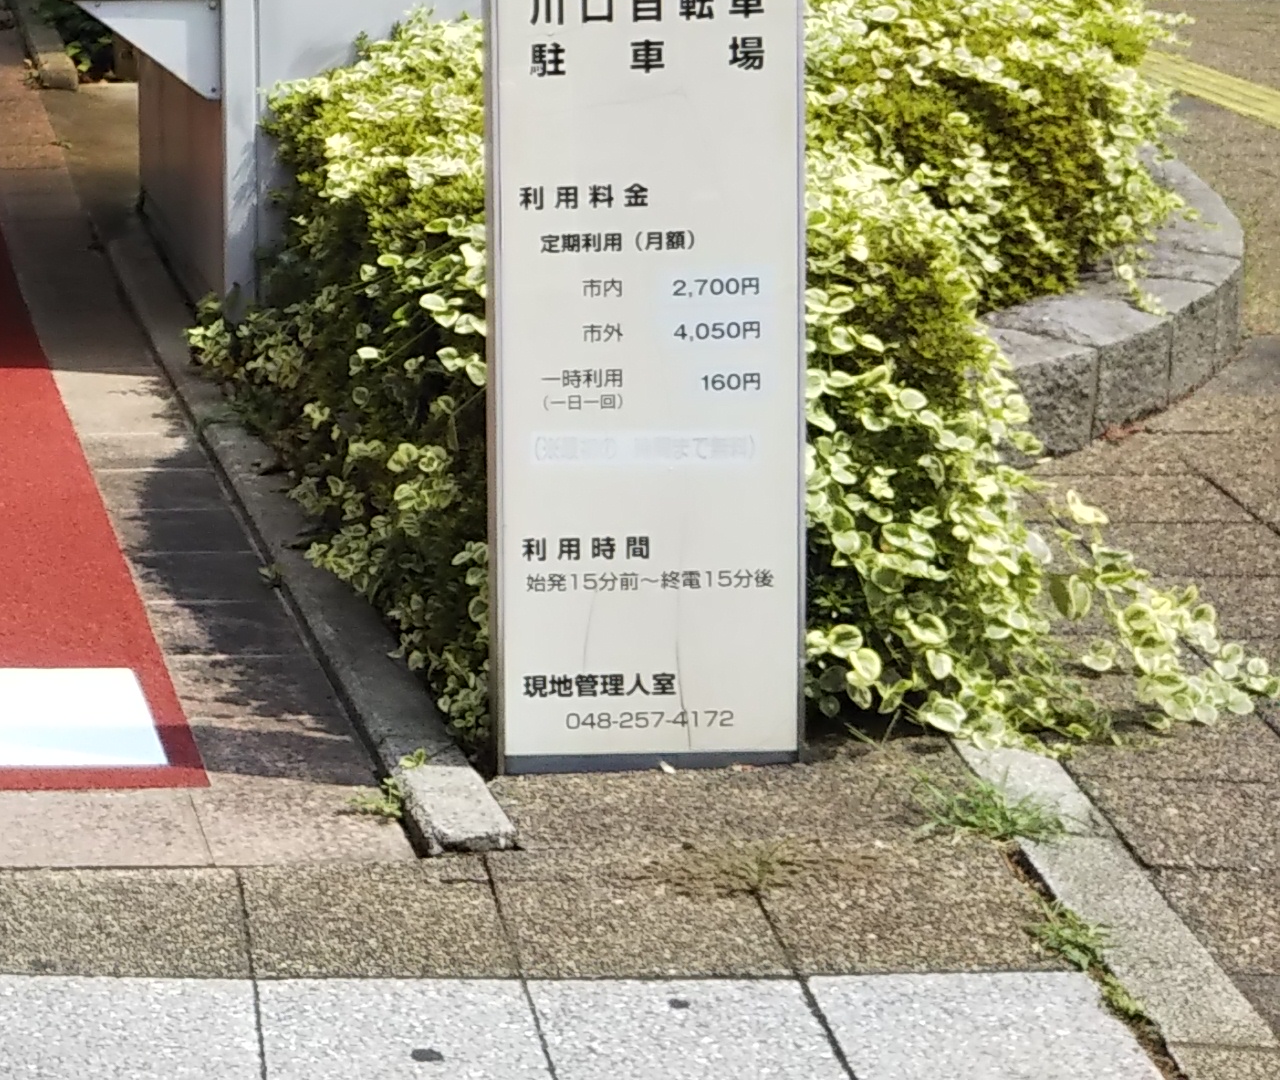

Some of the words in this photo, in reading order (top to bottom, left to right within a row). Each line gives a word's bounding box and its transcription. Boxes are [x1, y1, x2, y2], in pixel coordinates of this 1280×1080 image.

[530, 36, 765, 77] 駐車場
[519, 183, 649, 211] 利用料金
[582, 278, 623, 299] 市内
[671, 277, 760, 299] 2,700円
[582, 323, 624, 343] 市外
[673, 321, 761, 343] 4,050円
[541, 368, 623, 389] 一時利用
[700, 372, 761, 393] 160円
[521, 535, 651, 562] 利用時間
[523, 672, 677, 698] 現地管理人室
[566, 710, 735, 730] 048-257-4172
